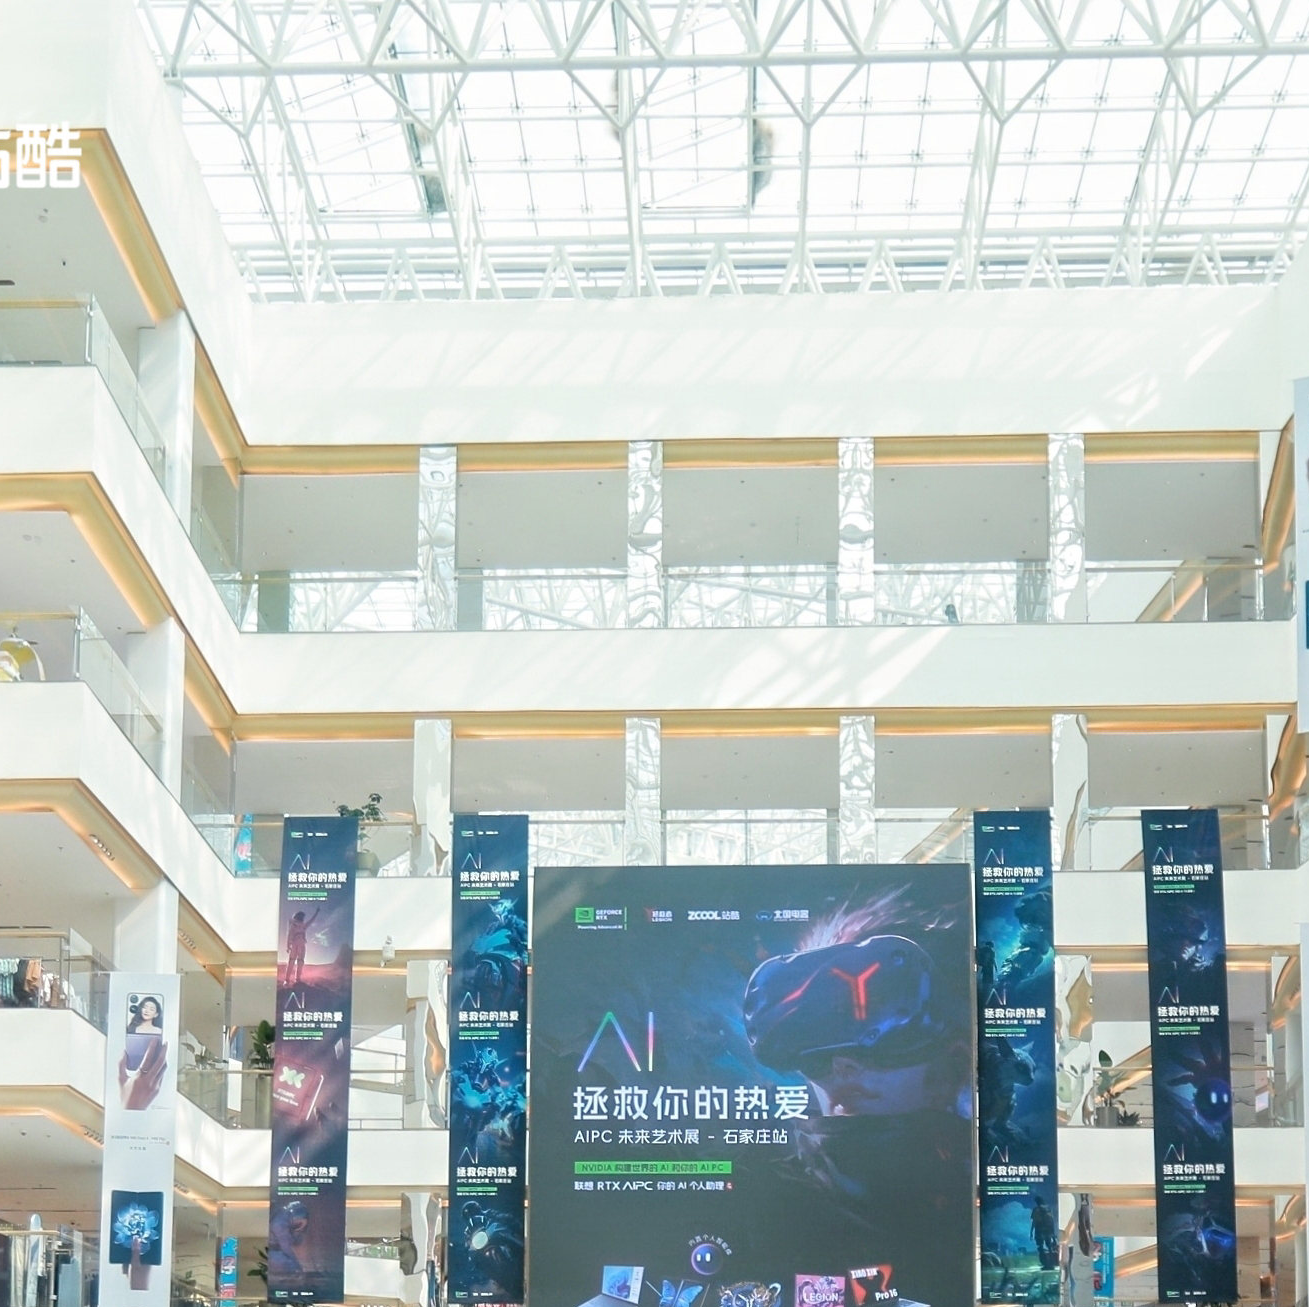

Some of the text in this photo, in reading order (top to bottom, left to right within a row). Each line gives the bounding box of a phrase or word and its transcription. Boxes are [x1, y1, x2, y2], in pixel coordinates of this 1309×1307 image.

[688, 910, 721, 921] ZCOOL
[576, 1011, 654, 1073] AI
[573, 1085, 810, 1122] 拯救你的热爱
[574, 1130, 613, 1144] AIPC
[618, 1128, 700, 1145] 未来艺术展
[722, 1128, 789, 1145] 石家庄站
[581, 1164, 613, 1172] NVIDIA
[660, 1164, 669, 1172] AI
[700, 1164, 710, 1172] AI
[711, 1164, 724, 1172] PC
[597, 1182, 620, 1191] RTX
[622, 1182, 653, 1191] AIPC
[656, 1181, 676, 1191] 你的
